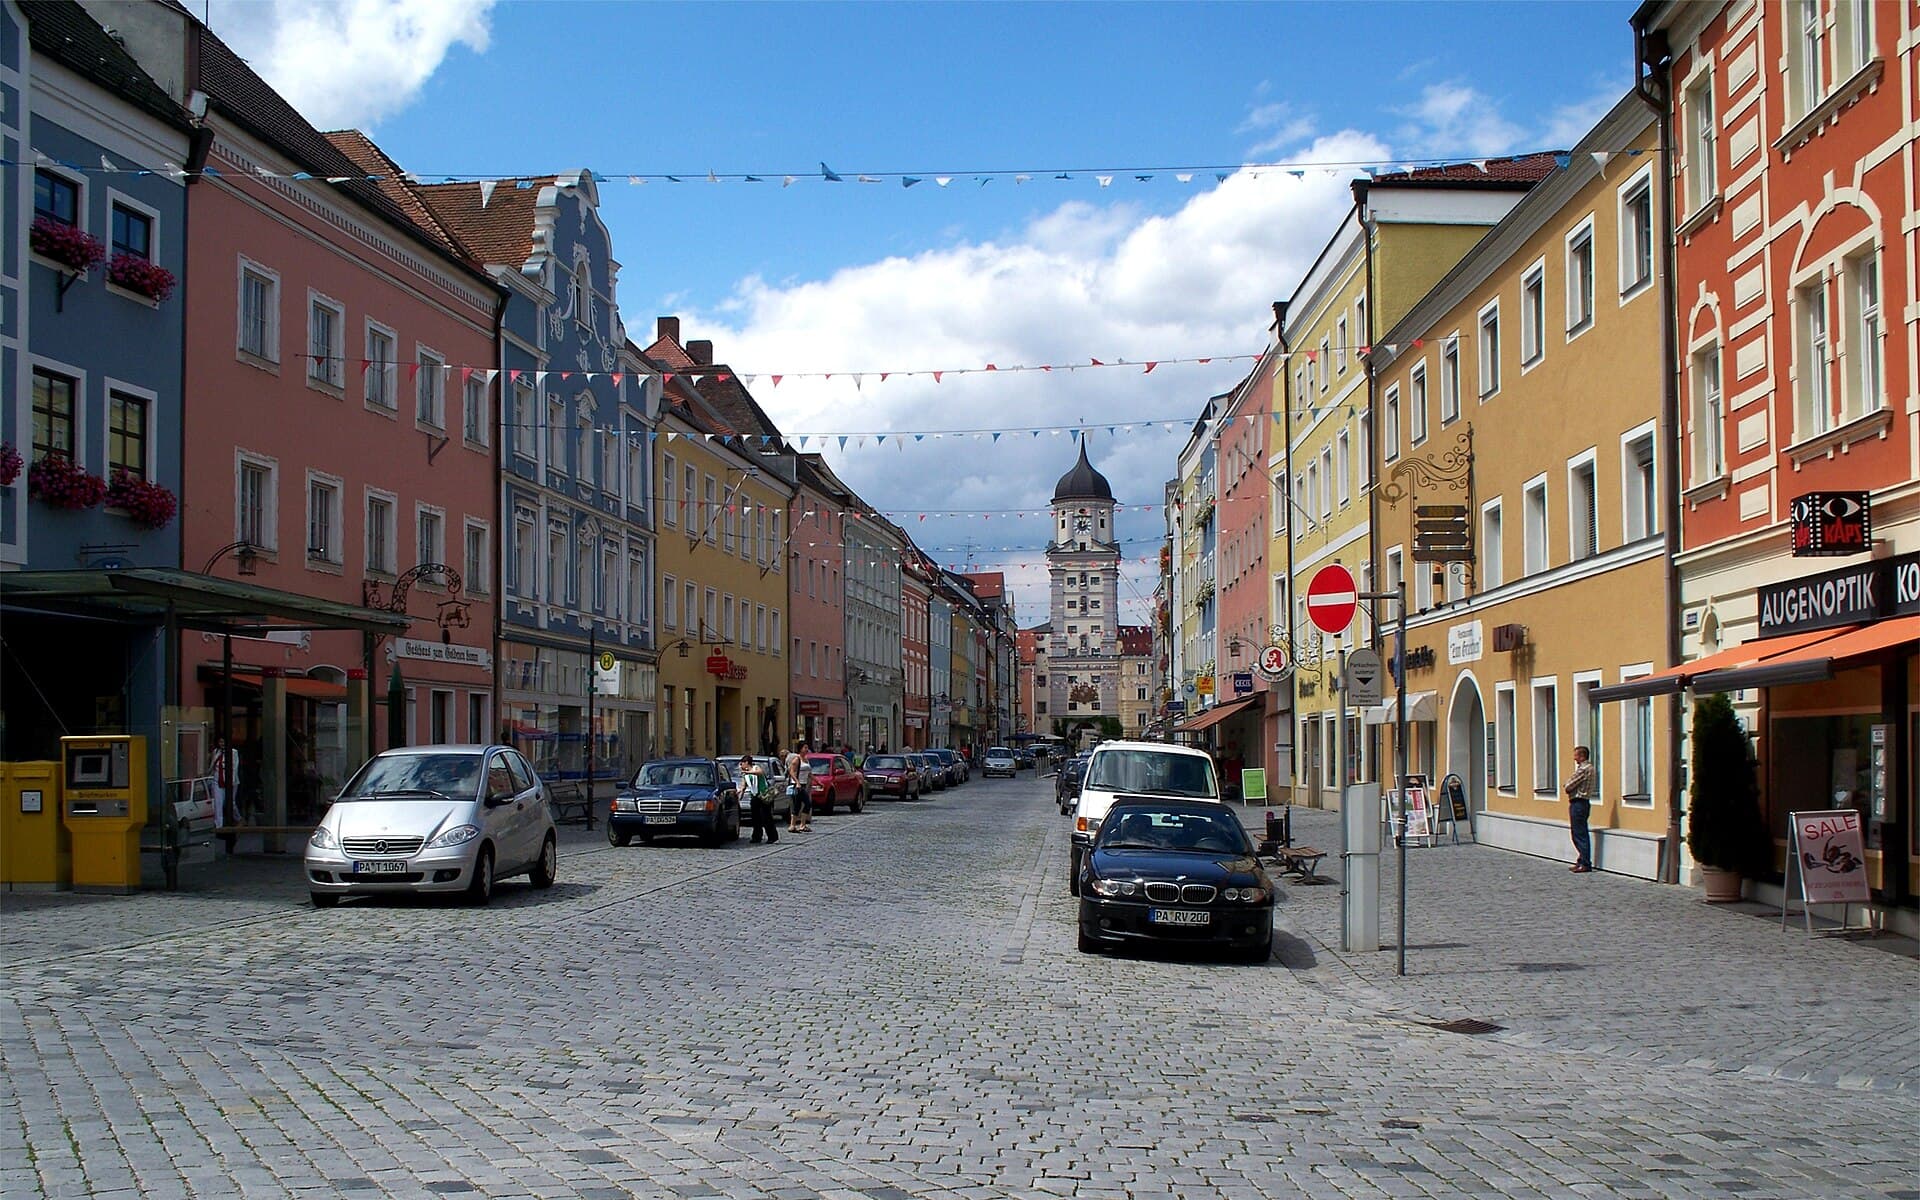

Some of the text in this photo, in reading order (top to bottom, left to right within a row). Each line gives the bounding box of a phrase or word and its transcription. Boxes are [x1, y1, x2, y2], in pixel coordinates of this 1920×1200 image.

[1824, 517, 1862, 543] KAPS
[1761, 571, 1876, 627] AUGENOPTIK
[1235, 679, 1251, 688] CECIL
[1805, 815, 1857, 840] SALE
[360, 862, 405, 872] PA T 1067
[1156, 911, 1209, 923] PA RV 200
